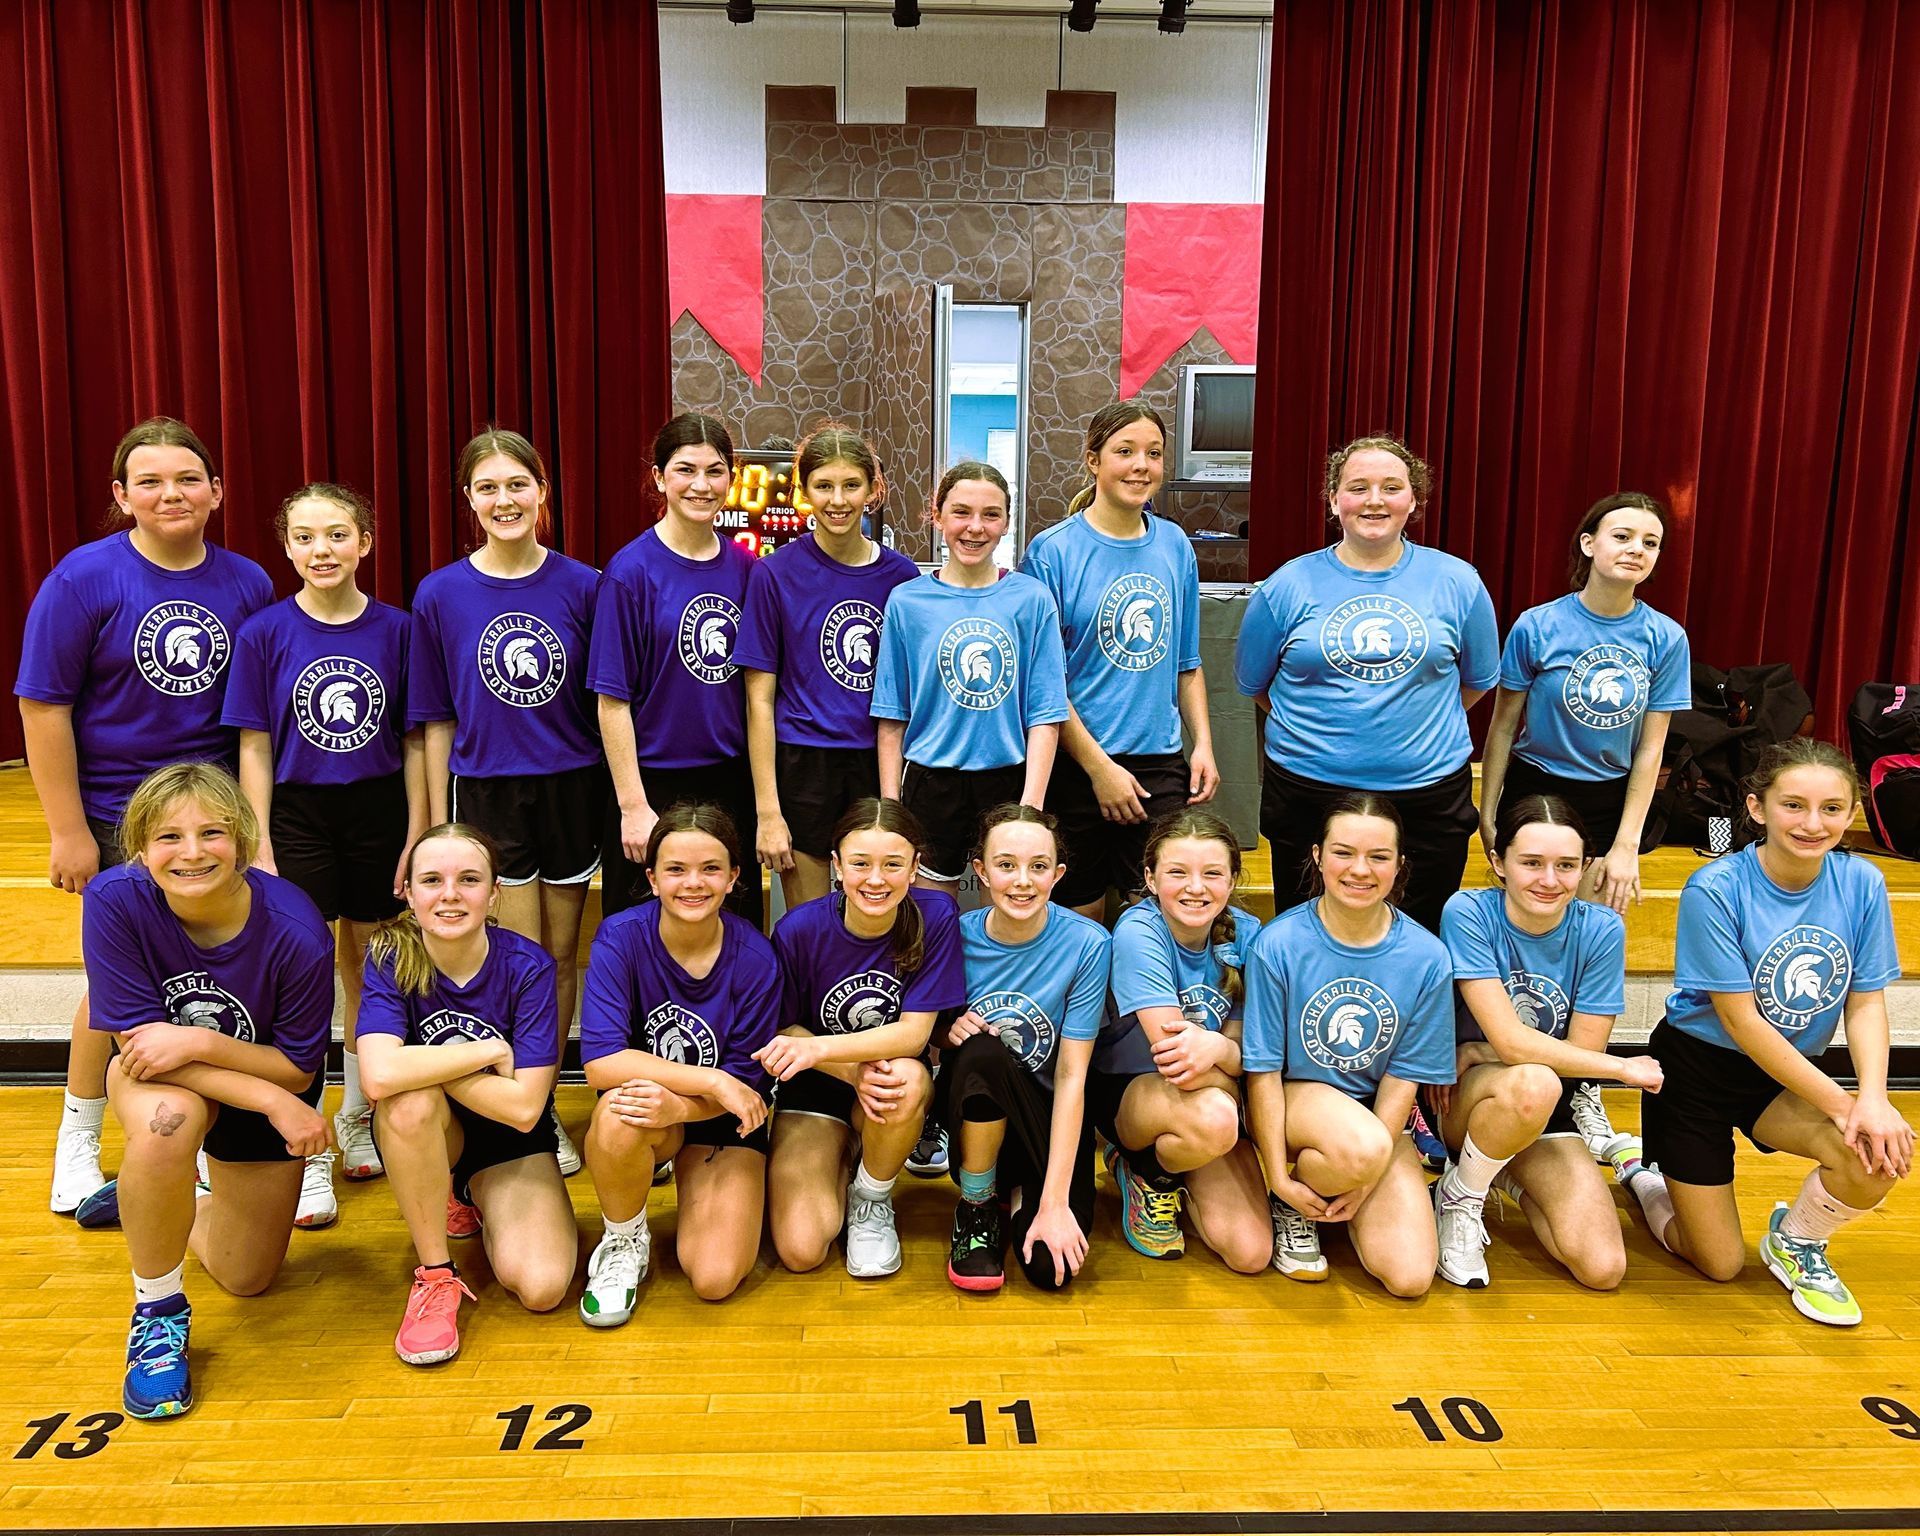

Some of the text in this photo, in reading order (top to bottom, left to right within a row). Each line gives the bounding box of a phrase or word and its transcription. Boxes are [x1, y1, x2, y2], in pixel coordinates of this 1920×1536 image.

[712, 511, 749, 528] OME
[766, 507, 796, 515] PERIOD
[683, 599, 741, 641] SHERRILLS FO
[1103, 578, 1152, 627] SHERRILLS
[1326, 599, 1424, 637] SHERRILLS FORD
[140, 606, 226, 650] SHERRILLS FORD
[482, 617, 563, 665] SHERRILLS FORD
[824, 605, 871, 646] SHERRILLS
[941, 622, 1014, 667] SHERRILLS FORD
[686, 653, 735, 680] OPTIMIS
[1104, 638, 1167, 668] OPTIMIST
[1329, 648, 1416, 680] OPTIMIST
[142, 660, 215, 692] OPTIMIST
[298, 661, 381, 706] SHERRILLS FORD
[489, 674, 559, 703] OPTIMIST
[827, 658, 873, 688] OPTIMI
[1626, 659, 1646, 690] FORD
[947, 679, 1008, 707] OPTIMIST
[1568, 696, 1638, 727] OPTIMIST
[301, 718, 377, 748] OPTIMIST
[1759, 930, 1847, 984] SHERRILLS FORD
[826, 975, 884, 1019] SHERRILLS
[1209, 995, 1229, 1020] FOR
[1305, 982, 1394, 1034] SHERRILLS FORD
[1549, 989, 1567, 1020] FORD
[976, 996, 1050, 1037] RRILLS FORD
[696, 1028, 714, 1065] FORD
[1306, 1038, 1378, 1069] OPTIMIST
[13, 1412, 125, 1459] 13
[496, 1403, 593, 1451] 12
[949, 1399, 1038, 1445] 11
[1392, 1397, 1503, 1442] 10
[1861, 1396, 1920, 1440] 9
